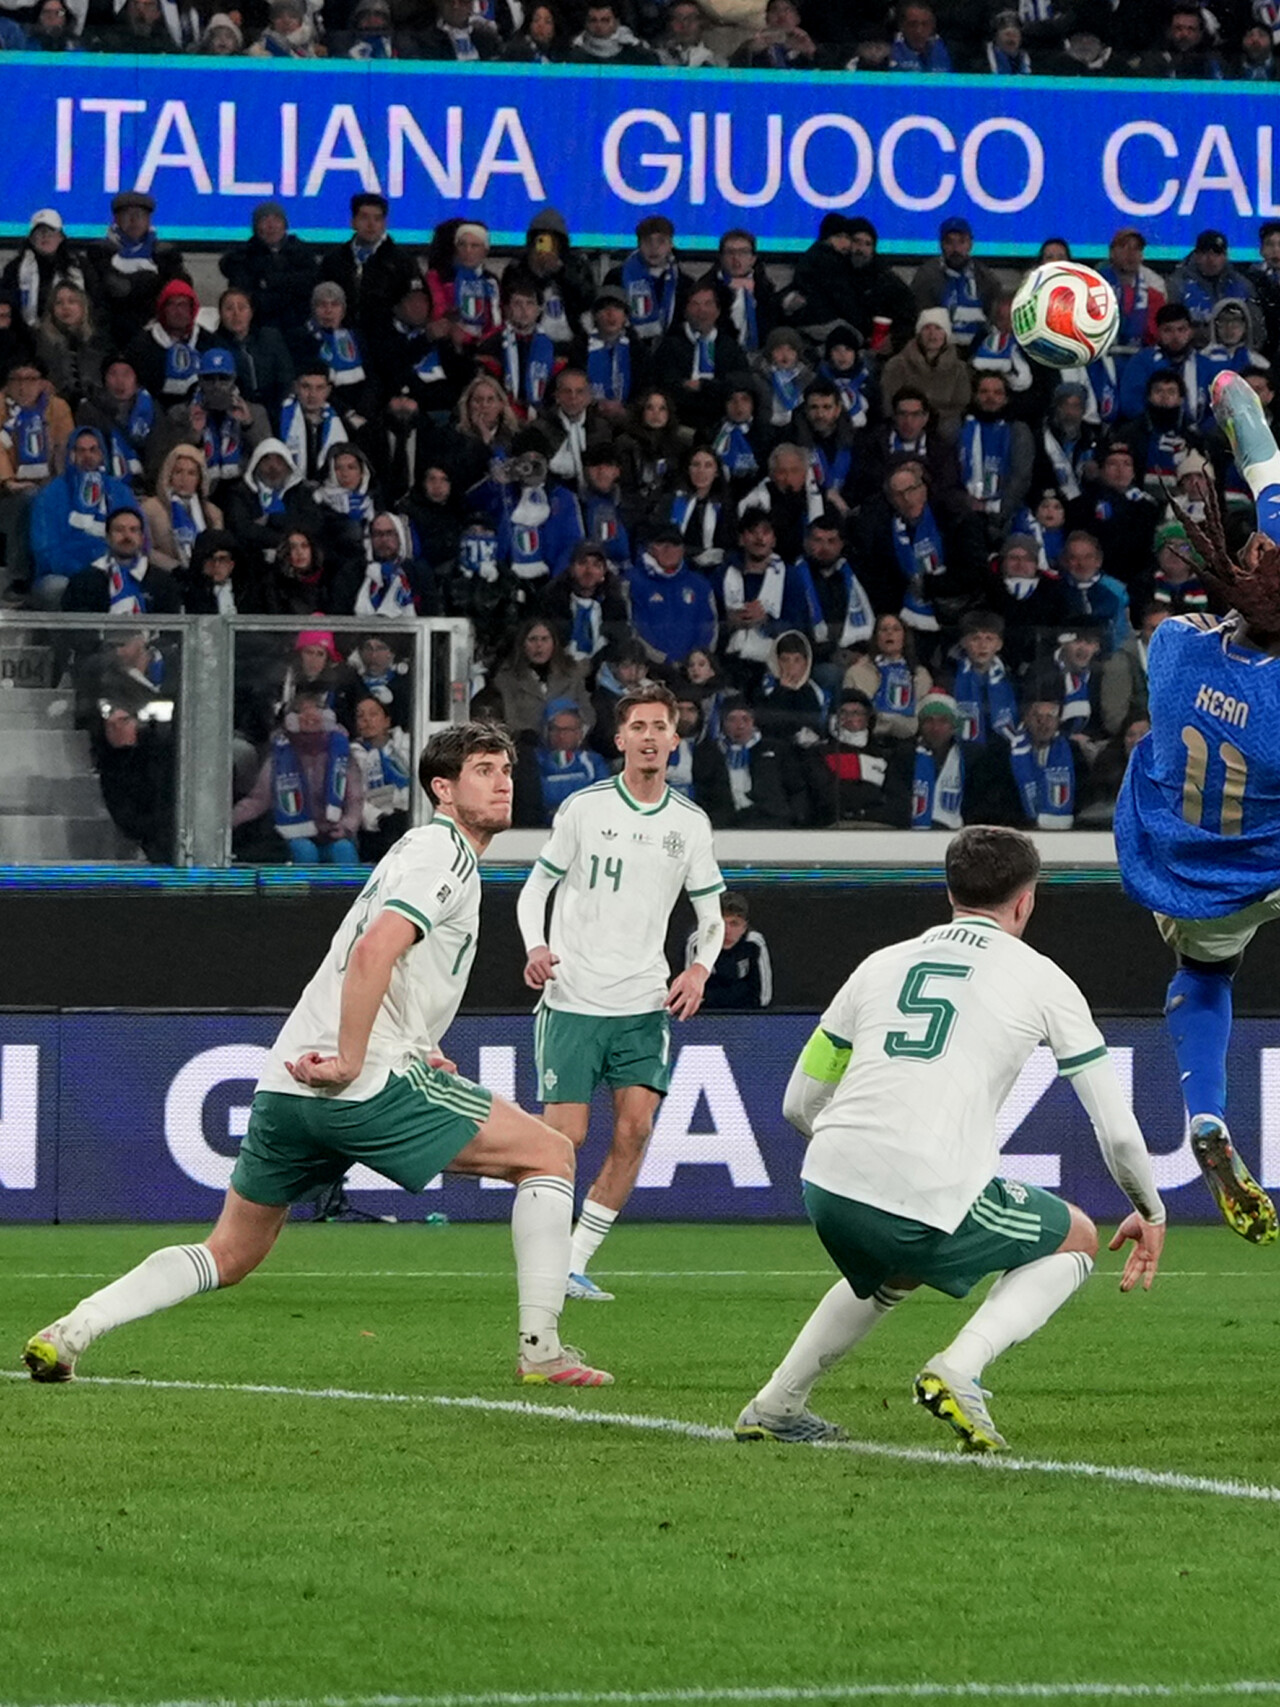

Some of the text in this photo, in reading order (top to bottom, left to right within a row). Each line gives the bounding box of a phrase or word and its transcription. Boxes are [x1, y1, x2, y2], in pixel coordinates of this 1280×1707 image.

[56, 97, 546, 200] ITALIANA
[603, 109, 1044, 212] GIUOCO
[1194, 684, 1249, 729] KEAN
[1181, 725, 1247, 836] 11
[589, 854, 623, 892] 14
[883, 961, 974, 1064] 5
